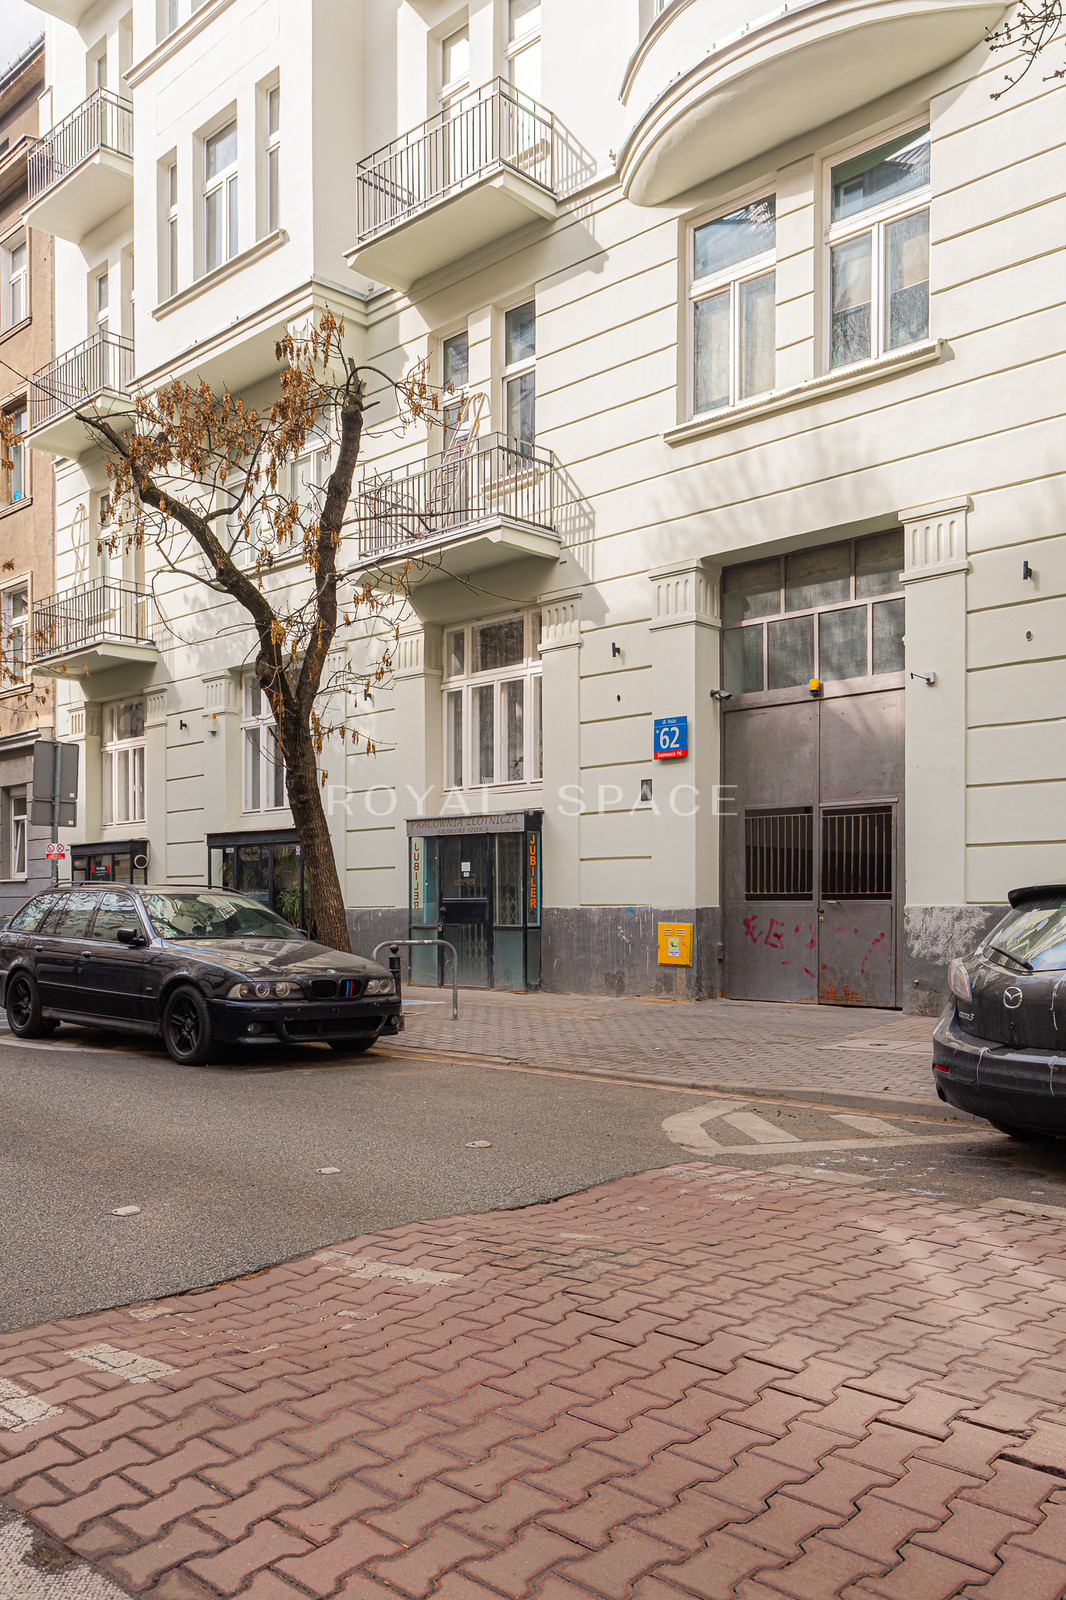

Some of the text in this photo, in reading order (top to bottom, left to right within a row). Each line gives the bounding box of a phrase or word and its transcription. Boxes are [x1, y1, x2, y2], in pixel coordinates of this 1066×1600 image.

[660, 727, 680, 748] 62
[411, 814, 518, 829] PRACOWNIA ZŁOTNICZA
